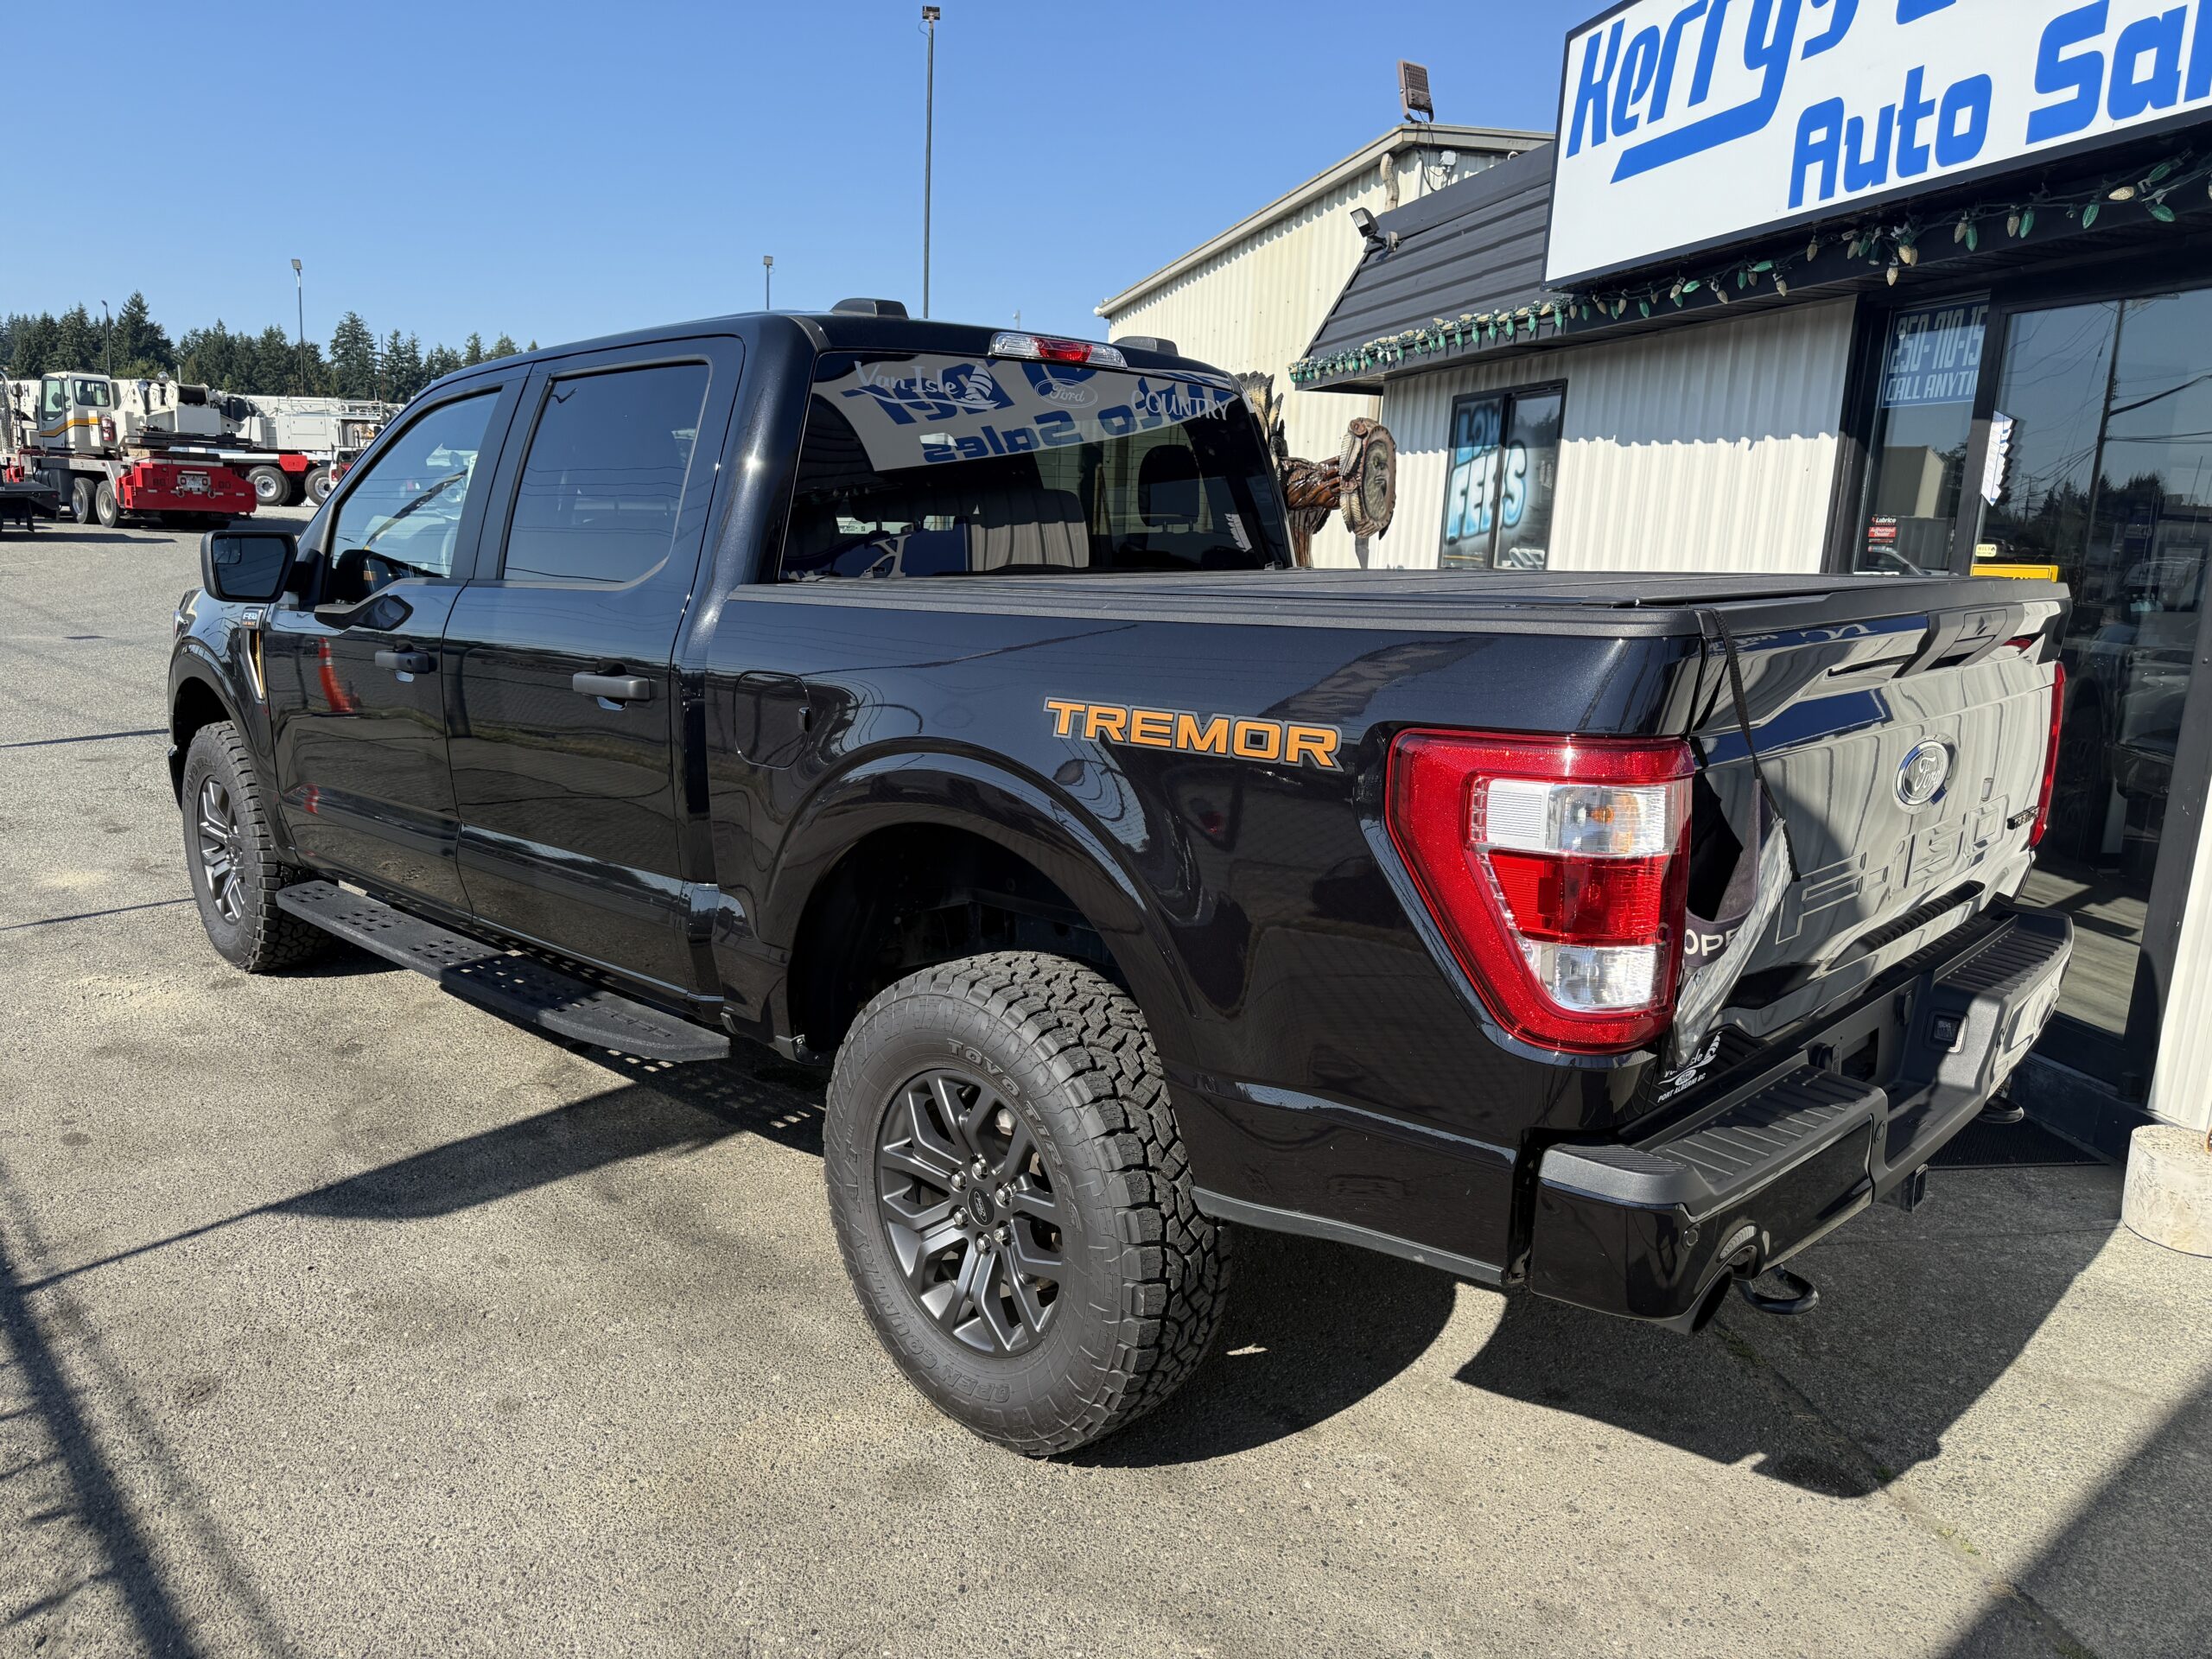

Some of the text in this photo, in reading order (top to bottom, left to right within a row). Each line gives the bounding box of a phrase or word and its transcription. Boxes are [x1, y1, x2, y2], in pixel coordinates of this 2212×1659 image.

[1788, 66, 1992, 210] Auto
[854, 360, 957, 396] Van Isle
[1048, 380, 1086, 404] Ford
[1885, 375, 1920, 402] CALL
[1130, 389, 1229, 422] COUNTRY
[1044, 696, 1344, 772] TREMOR
[1913, 755, 1944, 792] Ford
[1776, 793, 2010, 945] F-150
[947, 1038, 1020, 1096] TOYO
[1657, 1089, 1675, 1103] PORT
[1674, 1077, 1698, 1095] ALBERNI
[936, 1363, 1012, 1403] OPEN
